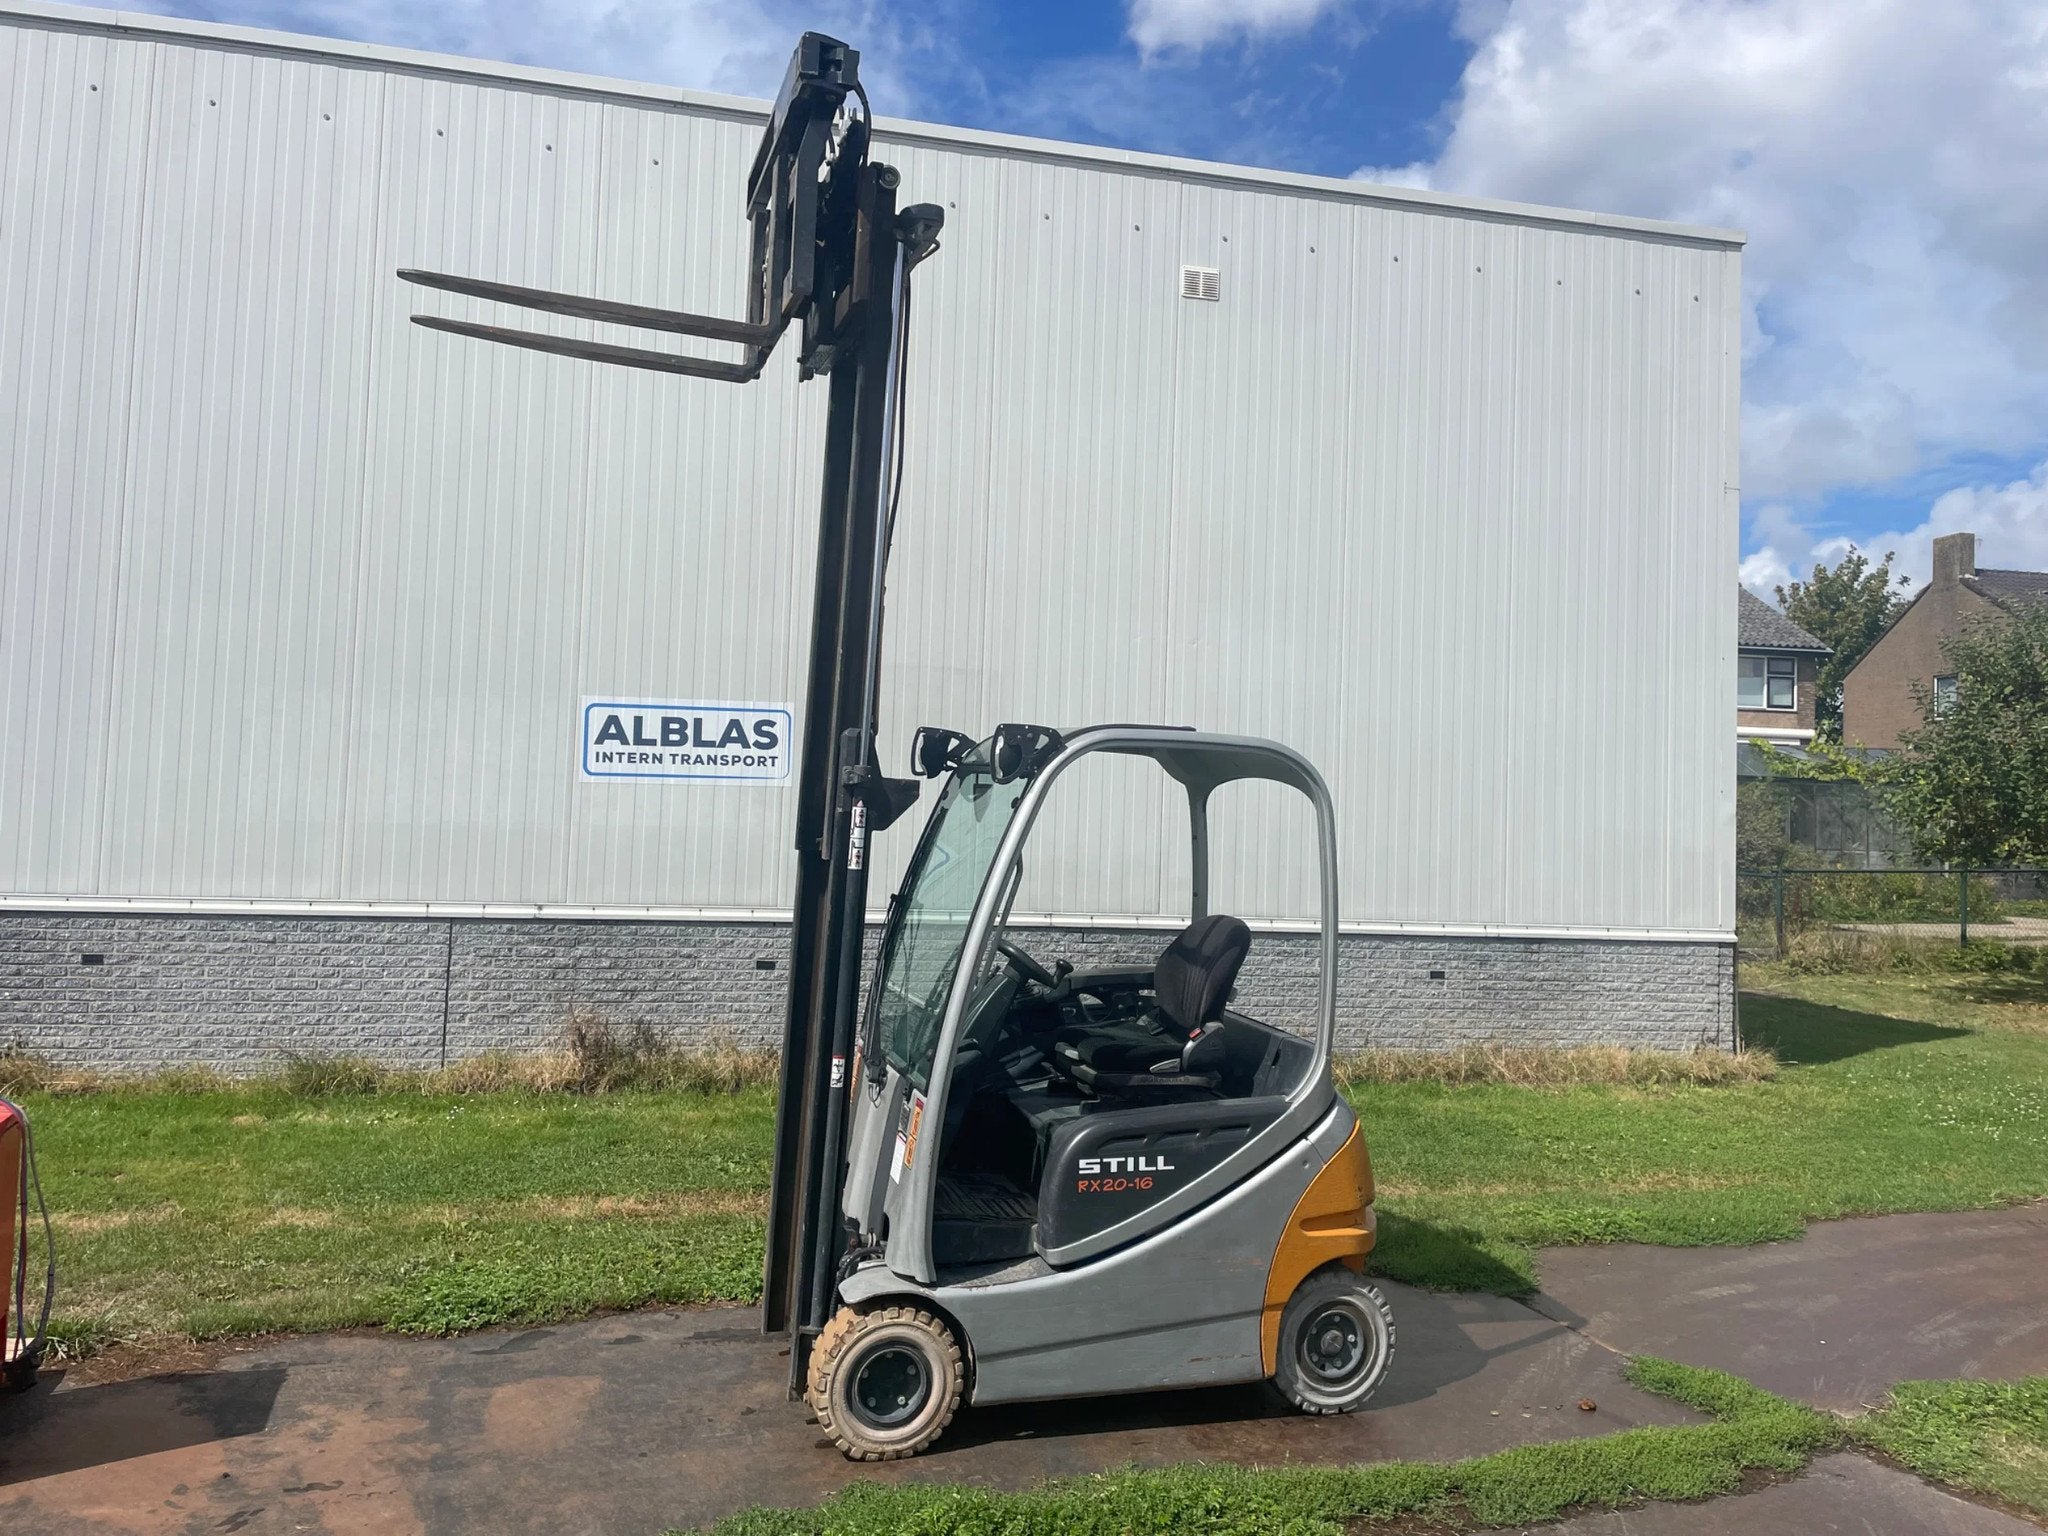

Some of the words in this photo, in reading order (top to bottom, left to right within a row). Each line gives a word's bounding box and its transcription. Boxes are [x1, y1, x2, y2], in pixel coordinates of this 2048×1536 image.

[594, 714, 779, 750] ALBLAS
[595, 751, 663, 764] INTERN
[669, 753, 779, 767] TRANSPORT
[1078, 1155, 1175, 1174] STILL
[1077, 1177, 1153, 1193] RX20-16
